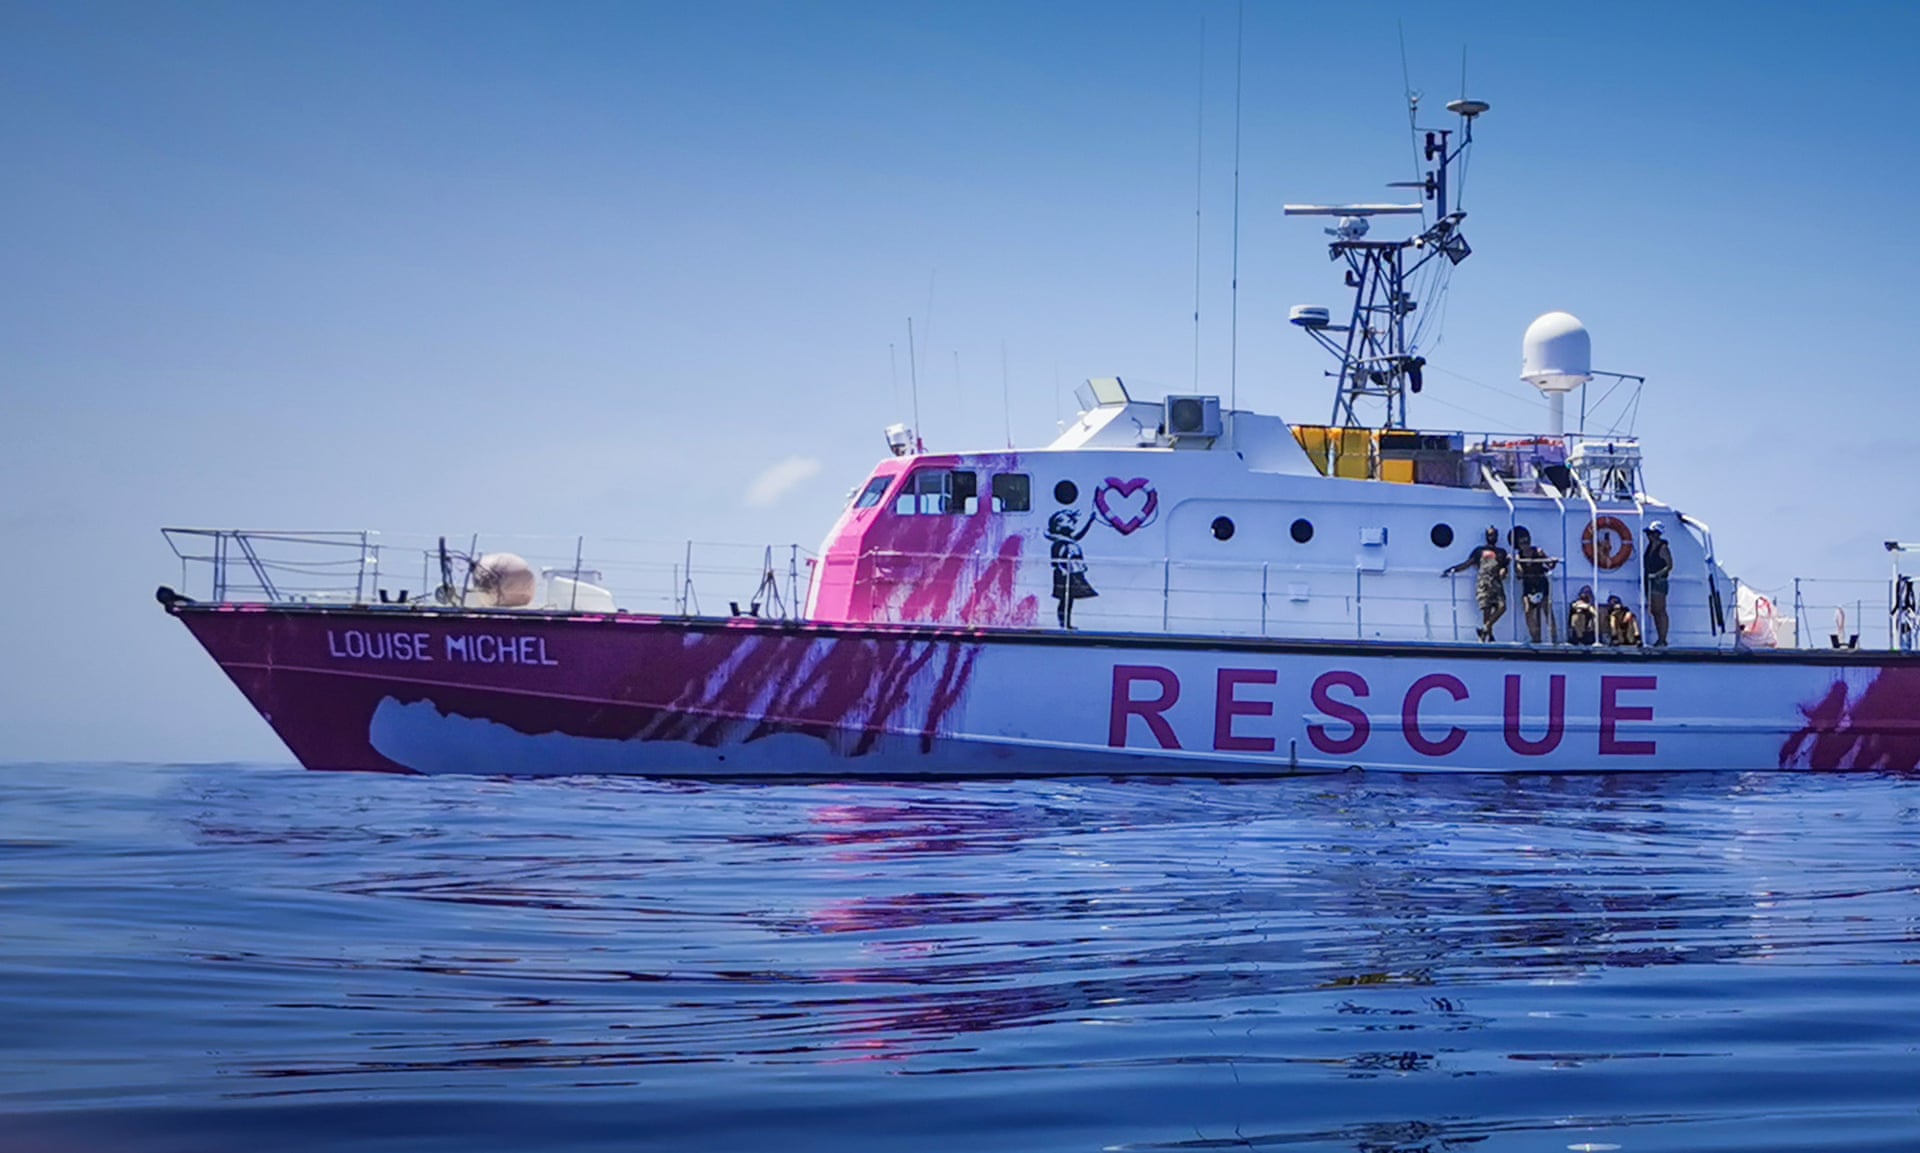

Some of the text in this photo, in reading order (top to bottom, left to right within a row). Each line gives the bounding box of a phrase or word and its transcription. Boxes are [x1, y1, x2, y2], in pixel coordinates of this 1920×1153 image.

[328, 630, 558, 665] LOUISE MICHEL
[1110, 665, 1657, 756] RESCUE
